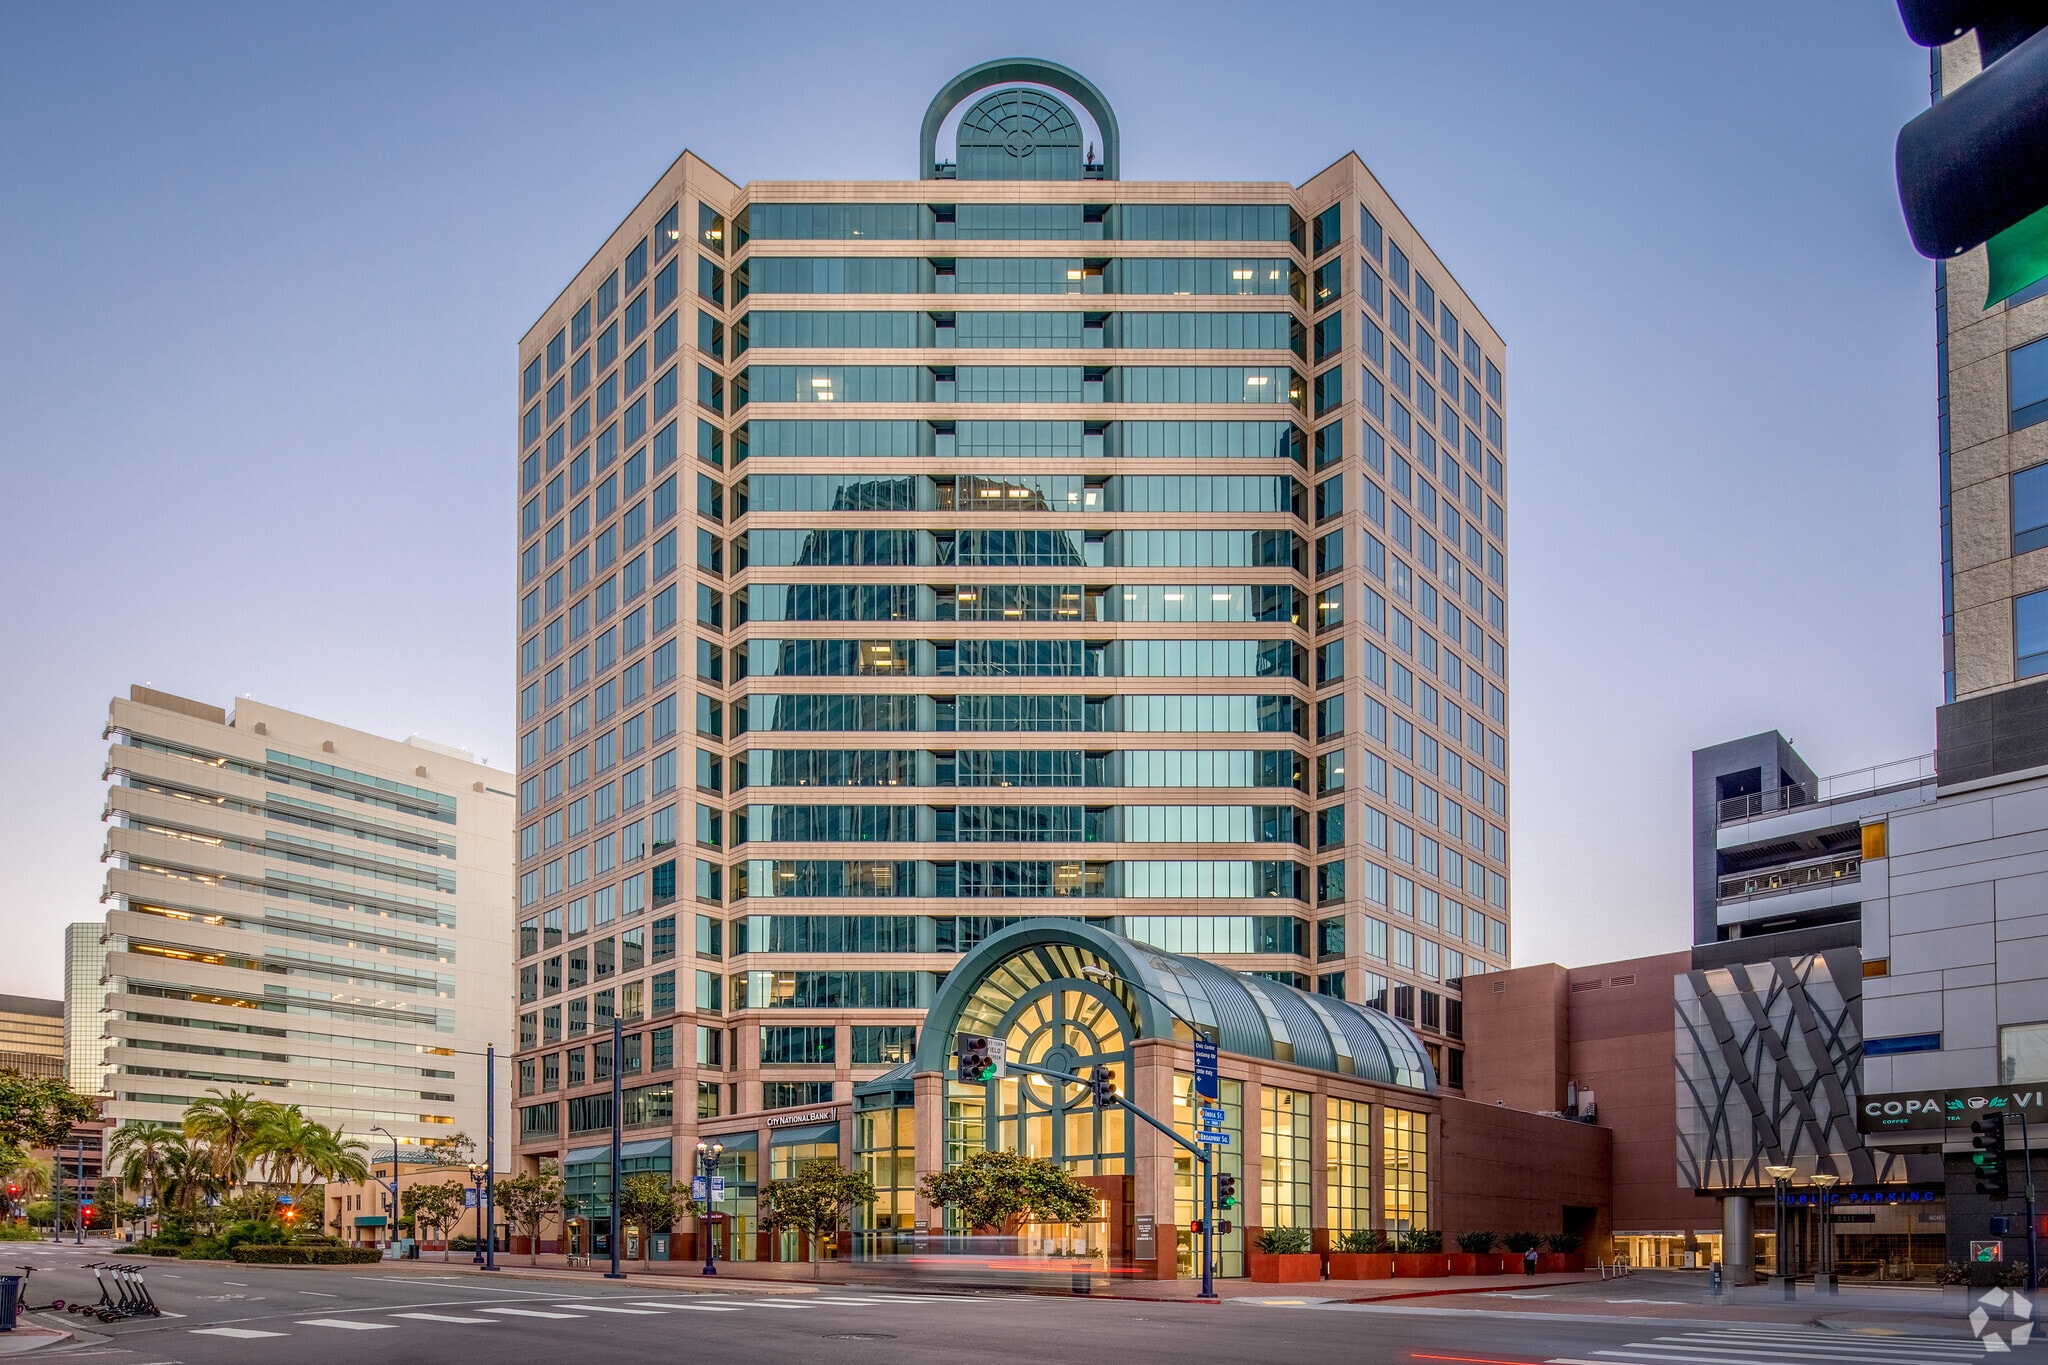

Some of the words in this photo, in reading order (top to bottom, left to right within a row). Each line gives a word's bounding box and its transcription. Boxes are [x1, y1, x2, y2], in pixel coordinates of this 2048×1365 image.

[1865, 1098, 1942, 1117] COPA
[2012, 1091, 2044, 1108] VI
[767, 1118, 780, 1126] CITY
[780, 1115, 810, 1125] NATIONAL
[810, 1112, 828, 1121] BANK
[1850, 1191, 1934, 1203] PARKING
